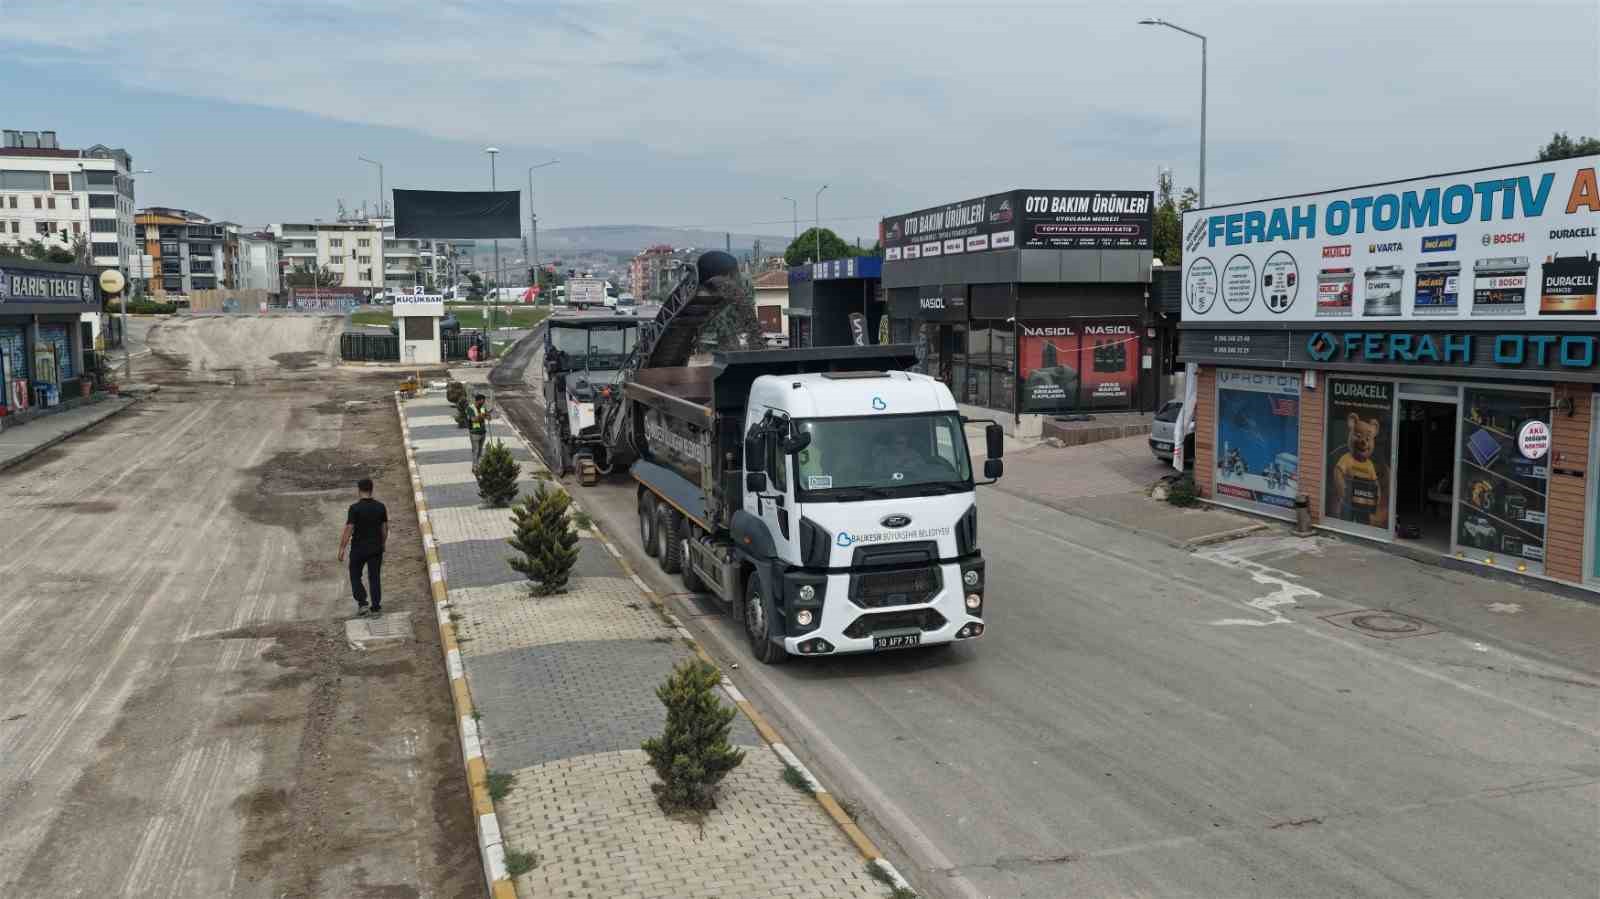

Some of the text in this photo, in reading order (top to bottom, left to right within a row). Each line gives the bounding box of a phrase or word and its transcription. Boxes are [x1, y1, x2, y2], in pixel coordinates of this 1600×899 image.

[1025, 193, 1150, 213] OTO BAKIM ÜRÜNLERİ
[904, 217, 918, 236] OTO
[919, 212, 944, 233] BAKIM
[1208, 204, 1317, 248] FERAH
[1493, 232, 1525, 244] BOSCH
[1549, 227, 1597, 240] DURACELL
[1377, 242, 1402, 252] VARTA
[49, 278, 78, 297] TEKEL
[1498, 278, 1522, 287] BOSCH
[1546, 276, 1593, 287] DURACELL
[415, 286, 423, 295] 2
[920, 297, 945, 309] NASIOL
[1024, 327, 1075, 336] NASIOL
[1085, 326, 1135, 335] NASIOL
[1344, 333, 1594, 367] FERAH OTO
[1333, 382, 1388, 399] DURACELL
